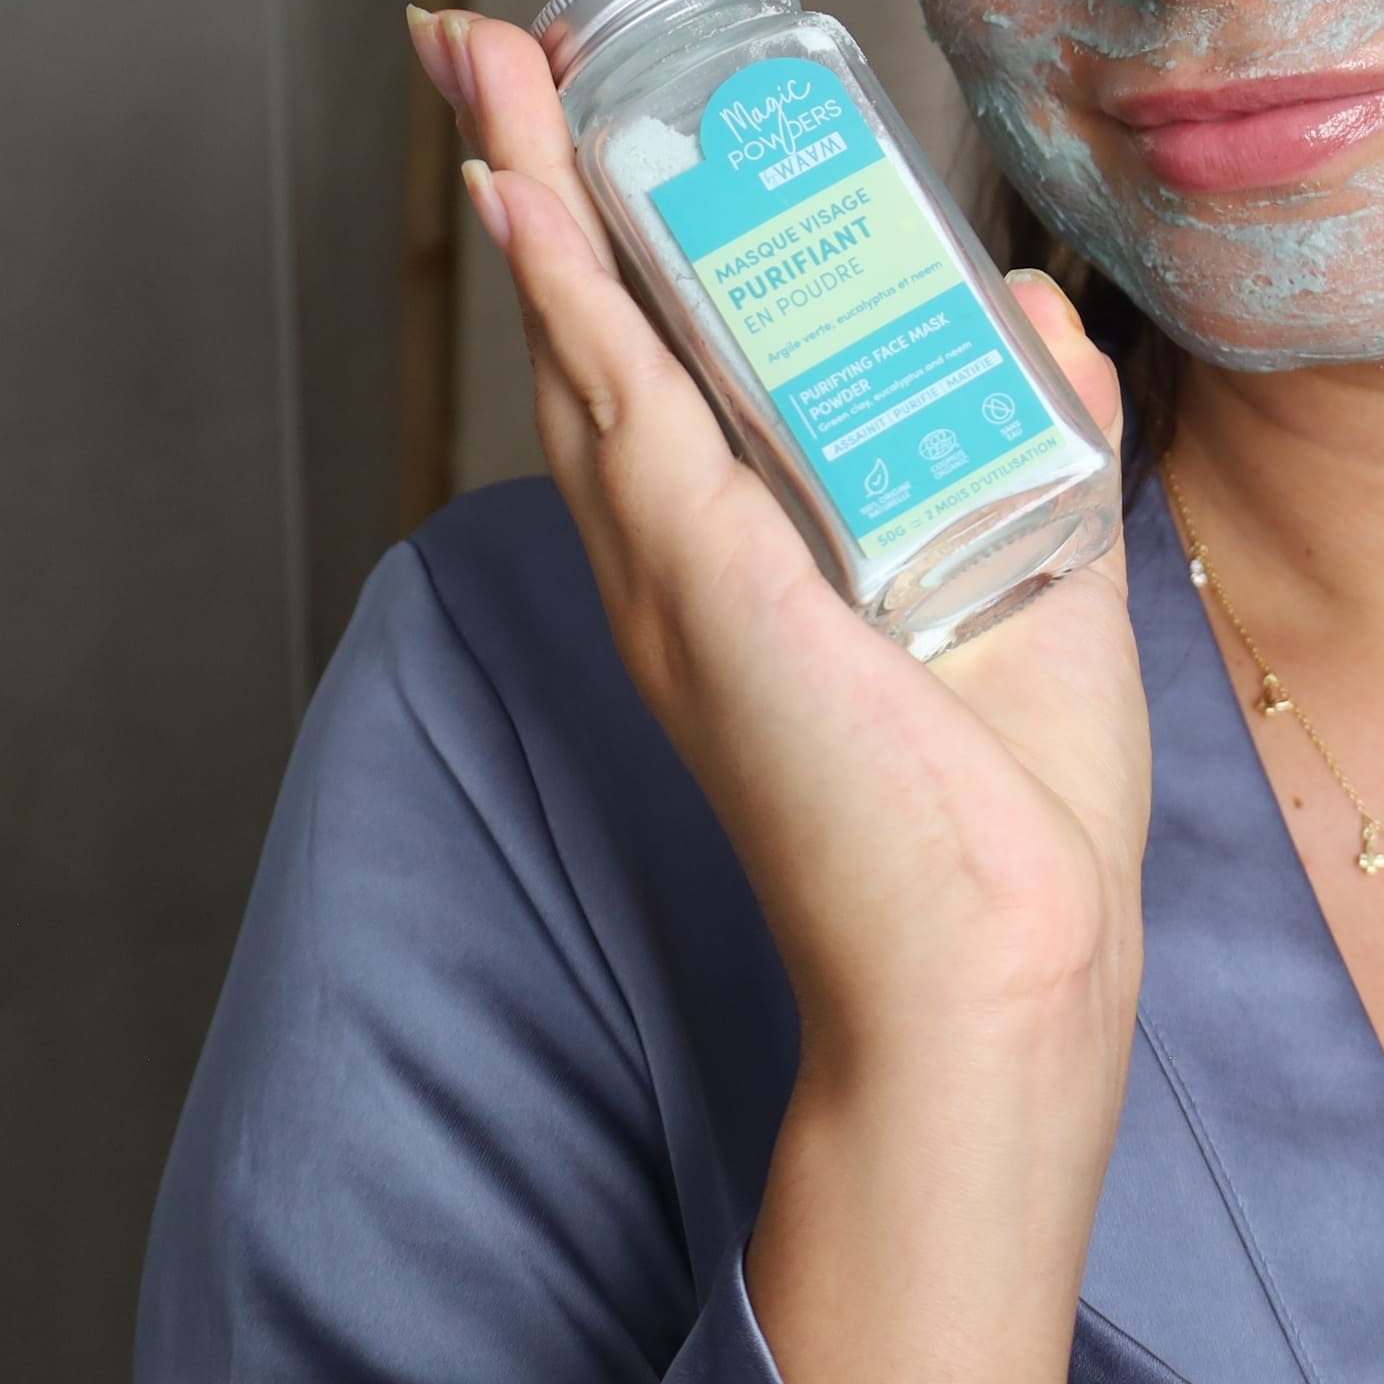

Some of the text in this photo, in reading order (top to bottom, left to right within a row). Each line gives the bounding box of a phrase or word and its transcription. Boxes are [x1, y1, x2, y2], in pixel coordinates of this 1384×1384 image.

[720, 79, 811, 154] Magic
[715, 187, 871, 284] MASQUE VISAGE
[728, 216, 871, 310] PURIFIANT
[744, 257, 864, 334] EN POUDRE
[898, 277, 909, 289] et
[910, 260, 943, 282] neem
[799, 312, 950, 404] PURIFYING FACE MASK
[809, 378, 872, 421] POWDER
[877, 525, 907, 547] 50G
[935, 488, 970, 514] MOIS
